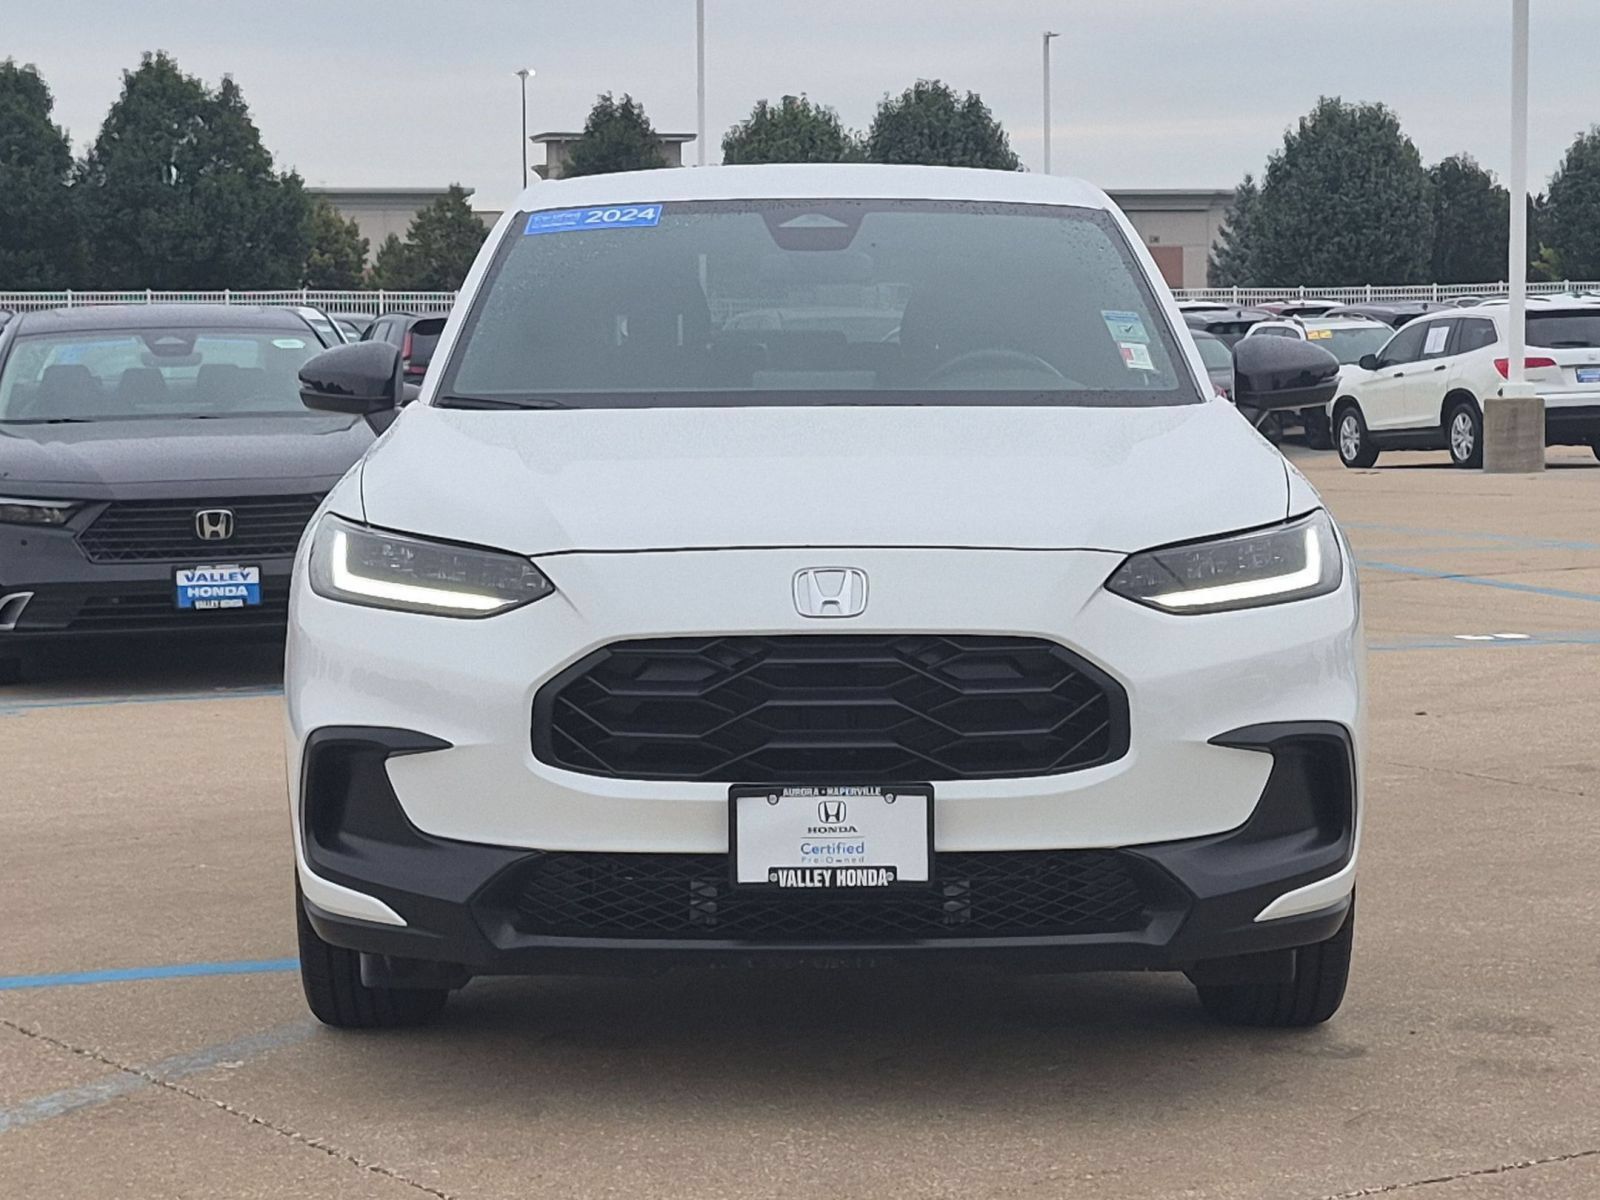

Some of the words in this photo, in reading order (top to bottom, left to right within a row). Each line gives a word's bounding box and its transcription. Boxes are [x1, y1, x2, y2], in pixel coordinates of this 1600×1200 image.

[584, 207, 655, 224] 2024
[184, 571, 251, 583] VALLEY
[187, 585, 248, 598] HONDA
[782, 787, 819, 796] AURORA
[826, 786, 881, 796] NAPERVILLE
[807, 826, 858, 834] HONDA
[800, 842, 865, 855] Certified
[778, 868, 832, 888] VALLEY
[836, 868, 889, 887] HONDA
